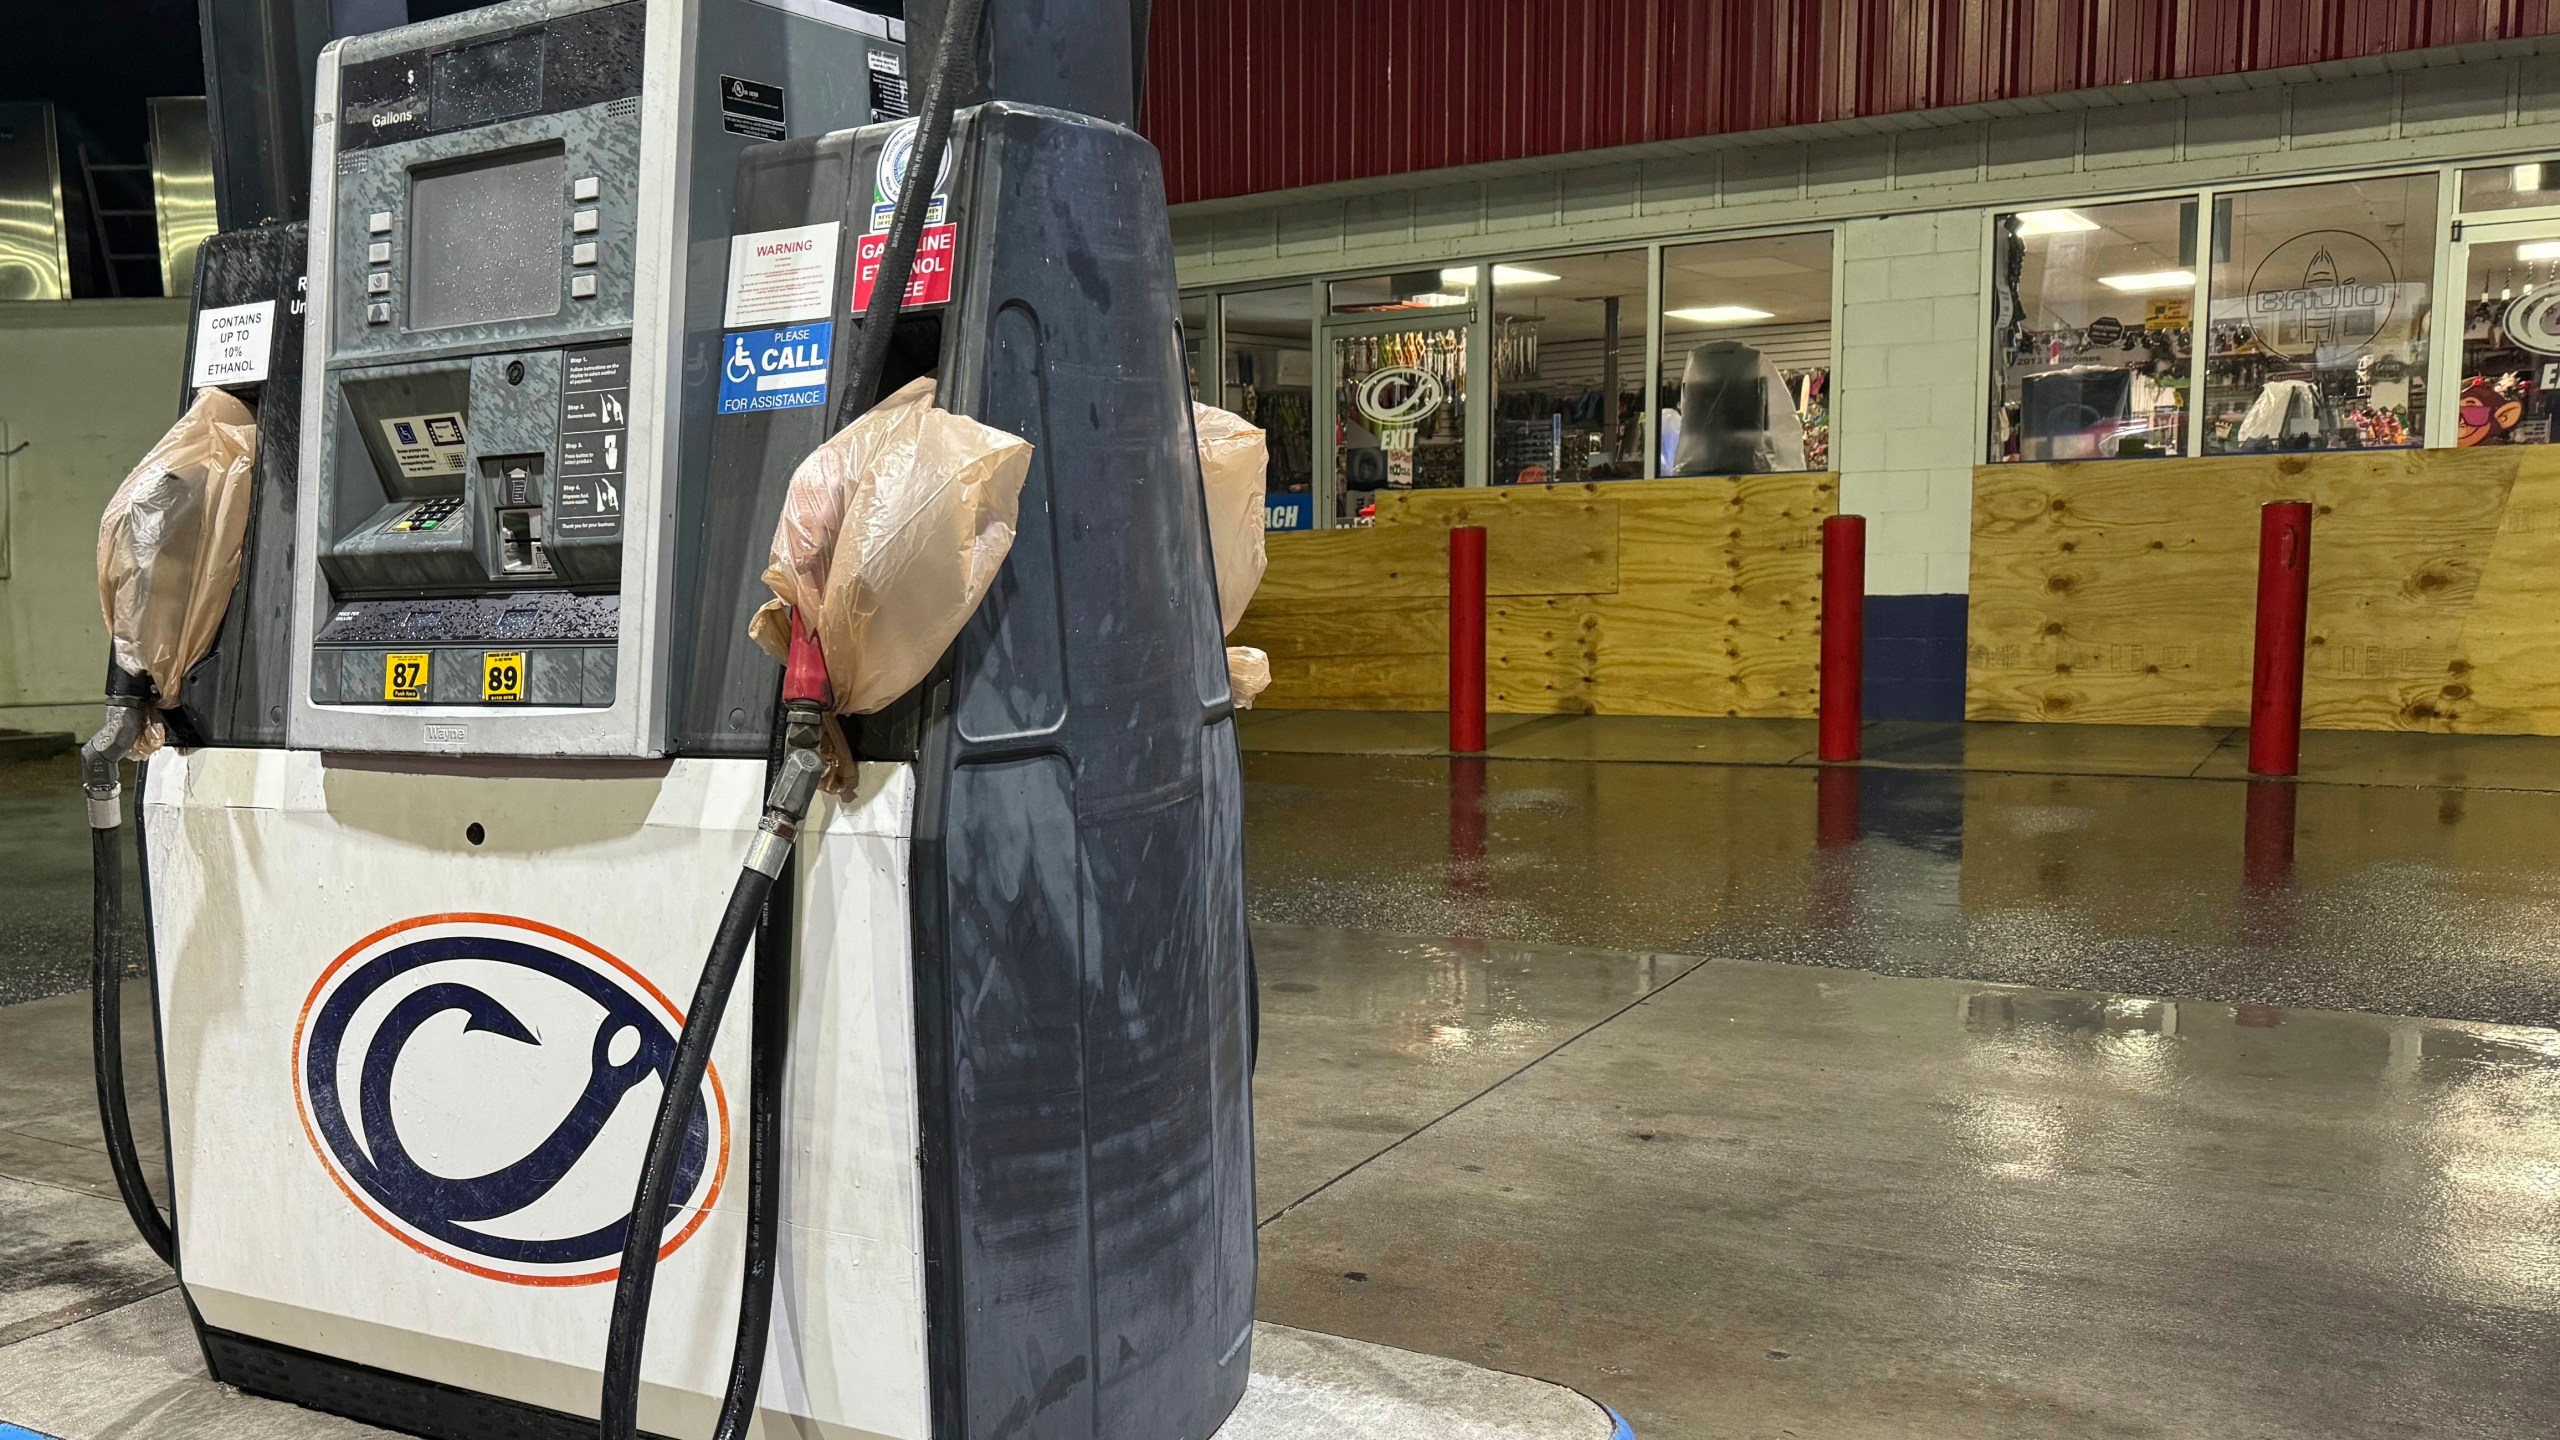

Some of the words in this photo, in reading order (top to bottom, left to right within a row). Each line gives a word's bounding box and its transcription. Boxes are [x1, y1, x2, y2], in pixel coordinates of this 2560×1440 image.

[372, 111, 412, 127] Gallons
[756, 240, 813, 257] WARNING
[862, 233, 951, 259] GAINE
[212, 313, 262, 329] CONTAINS
[220, 333, 233, 343] UP
[236, 330, 250, 341] TO
[775, 329, 810, 343] PLEASE
[224, 346, 243, 358] 10%
[761, 344, 824, 371] CALL
[208, 361, 254, 375] ETHANOL
[2540, 362, 2560, 390] E
[725, 397, 748, 411] FOR
[750, 390, 820, 409] ASSISTANCE
[1381, 428, 1418, 451] EXIT
[393, 663, 420, 688] 87
[489, 666, 517, 691] 89
[426, 725, 466, 742] Wayne
